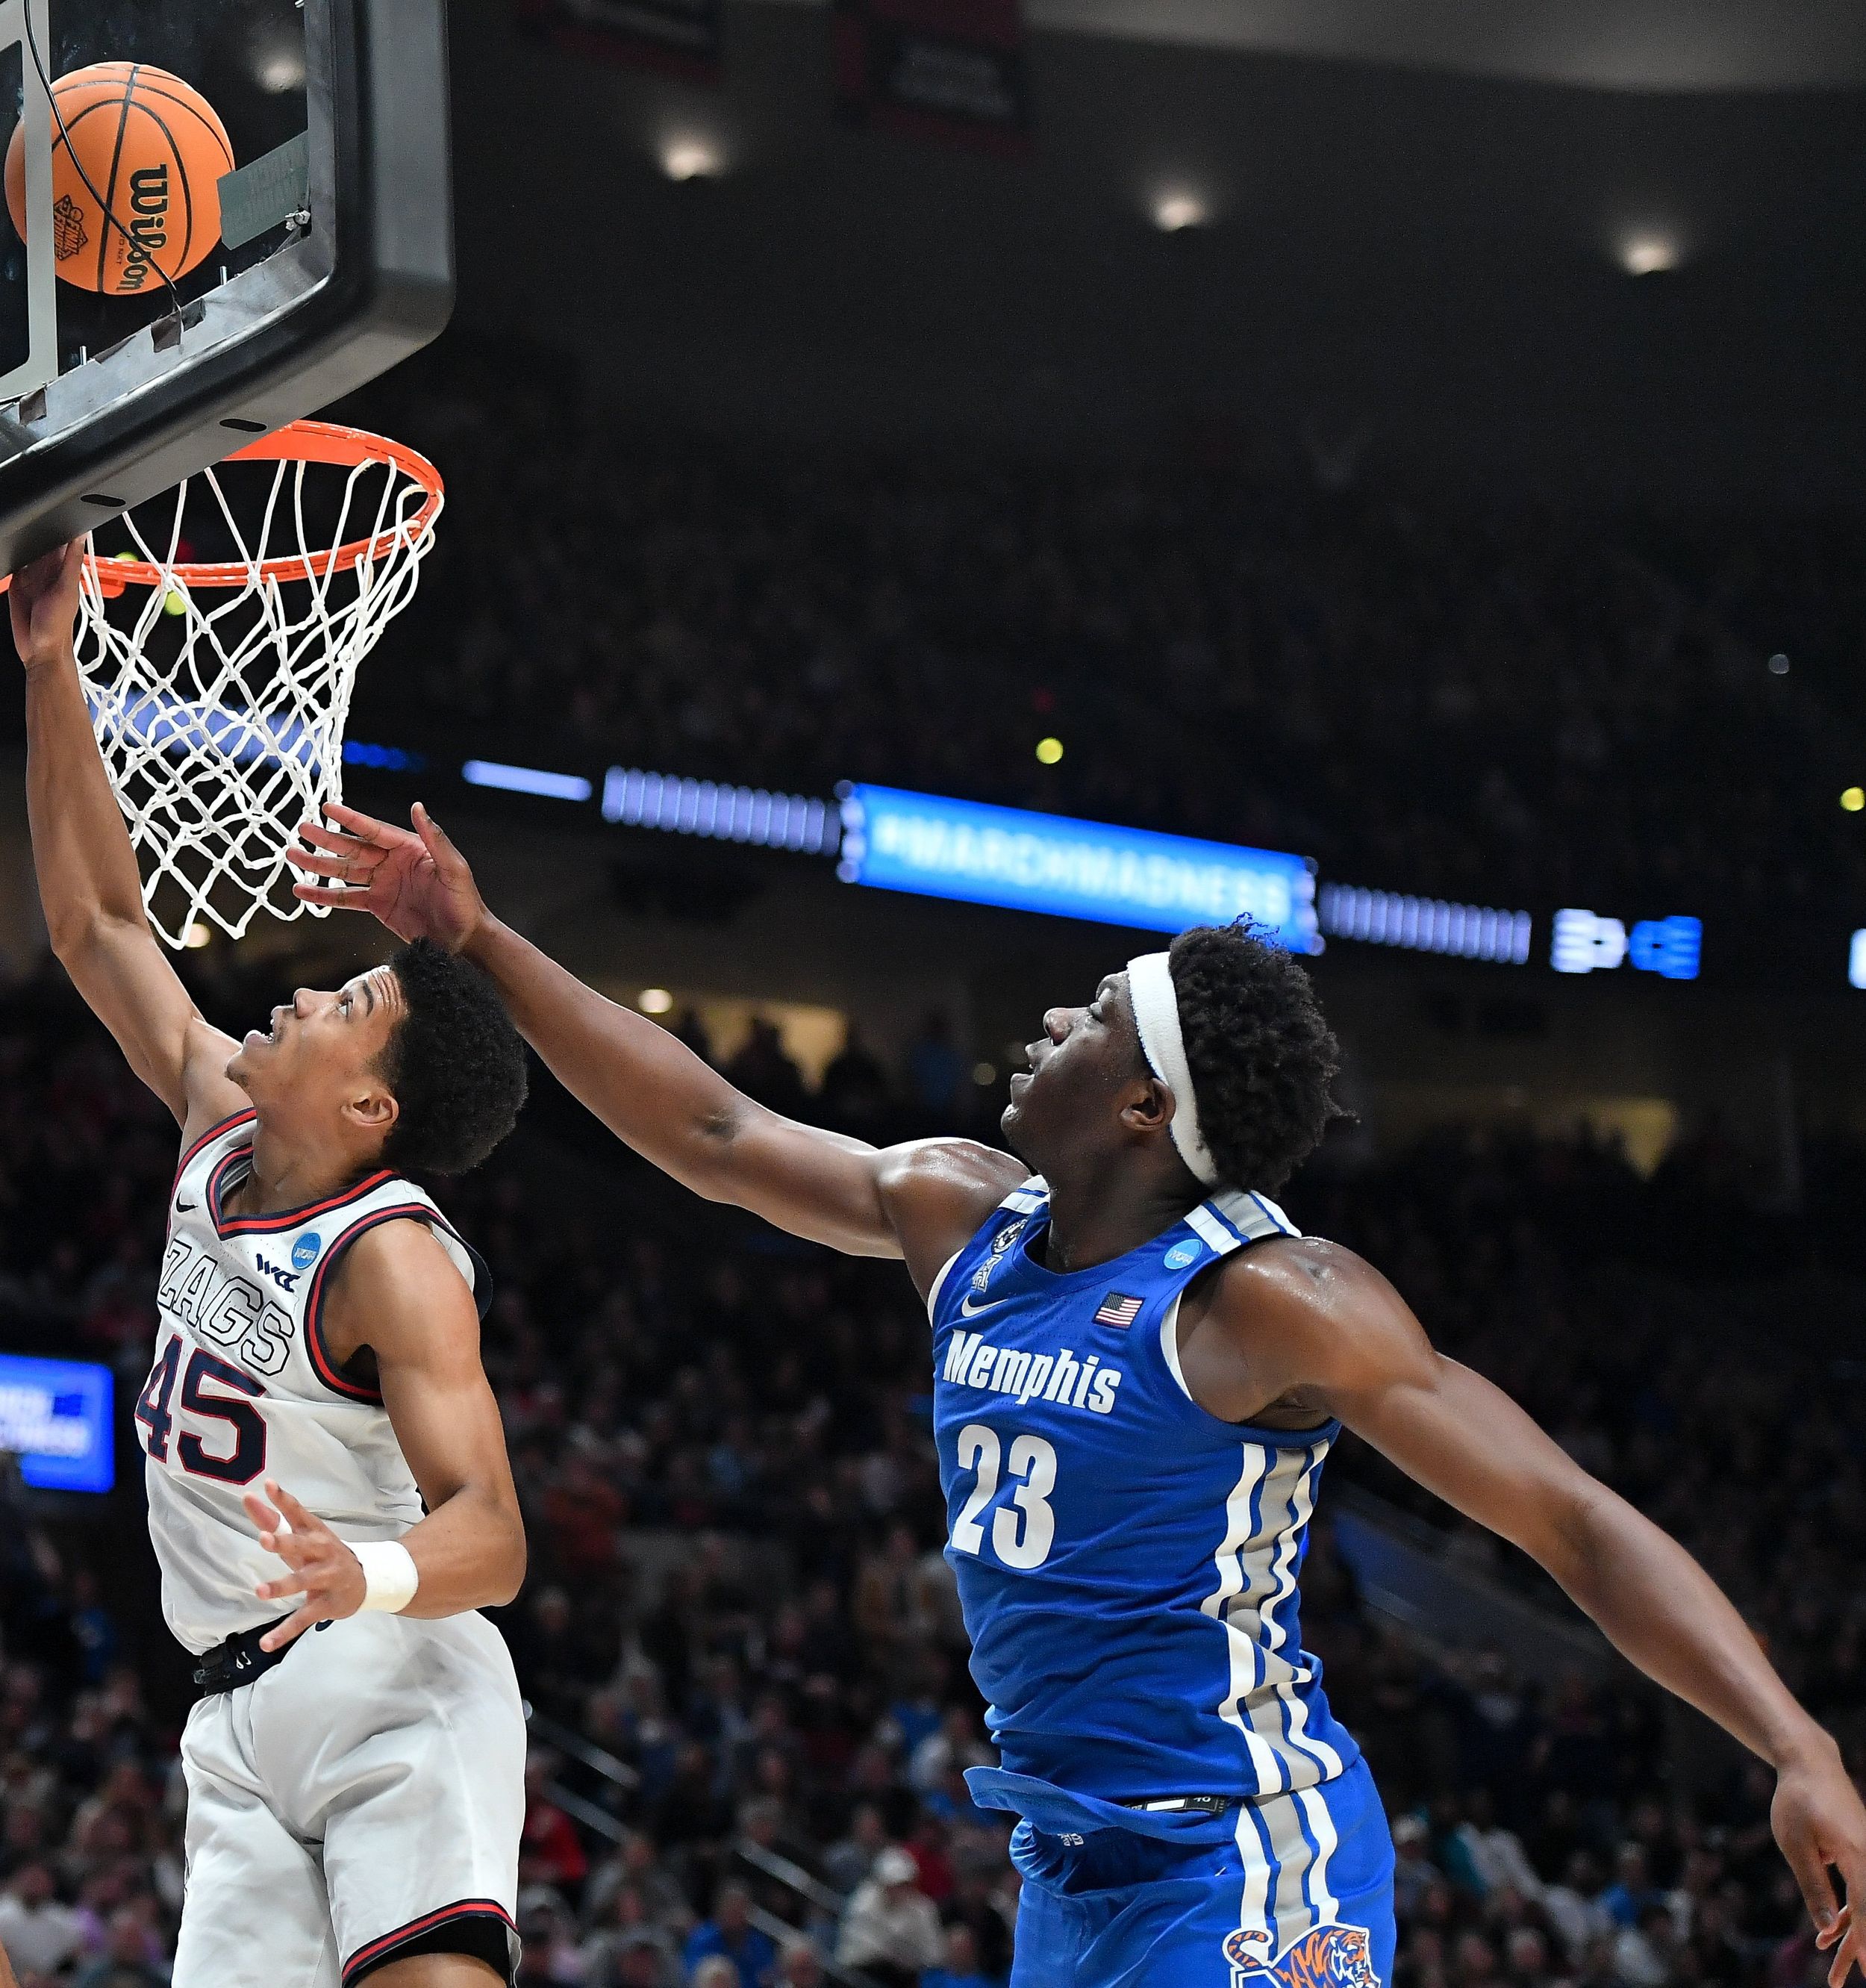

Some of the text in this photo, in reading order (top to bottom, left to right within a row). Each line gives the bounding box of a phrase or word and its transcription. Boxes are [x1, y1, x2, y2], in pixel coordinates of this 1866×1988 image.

[116, 163, 168, 292] Wilson
[157, 1238, 295, 1376] ZAGS
[943, 1329, 1121, 1413] Memphis
[134, 1333, 266, 1485] 45
[951, 1424, 1057, 1569] 23
